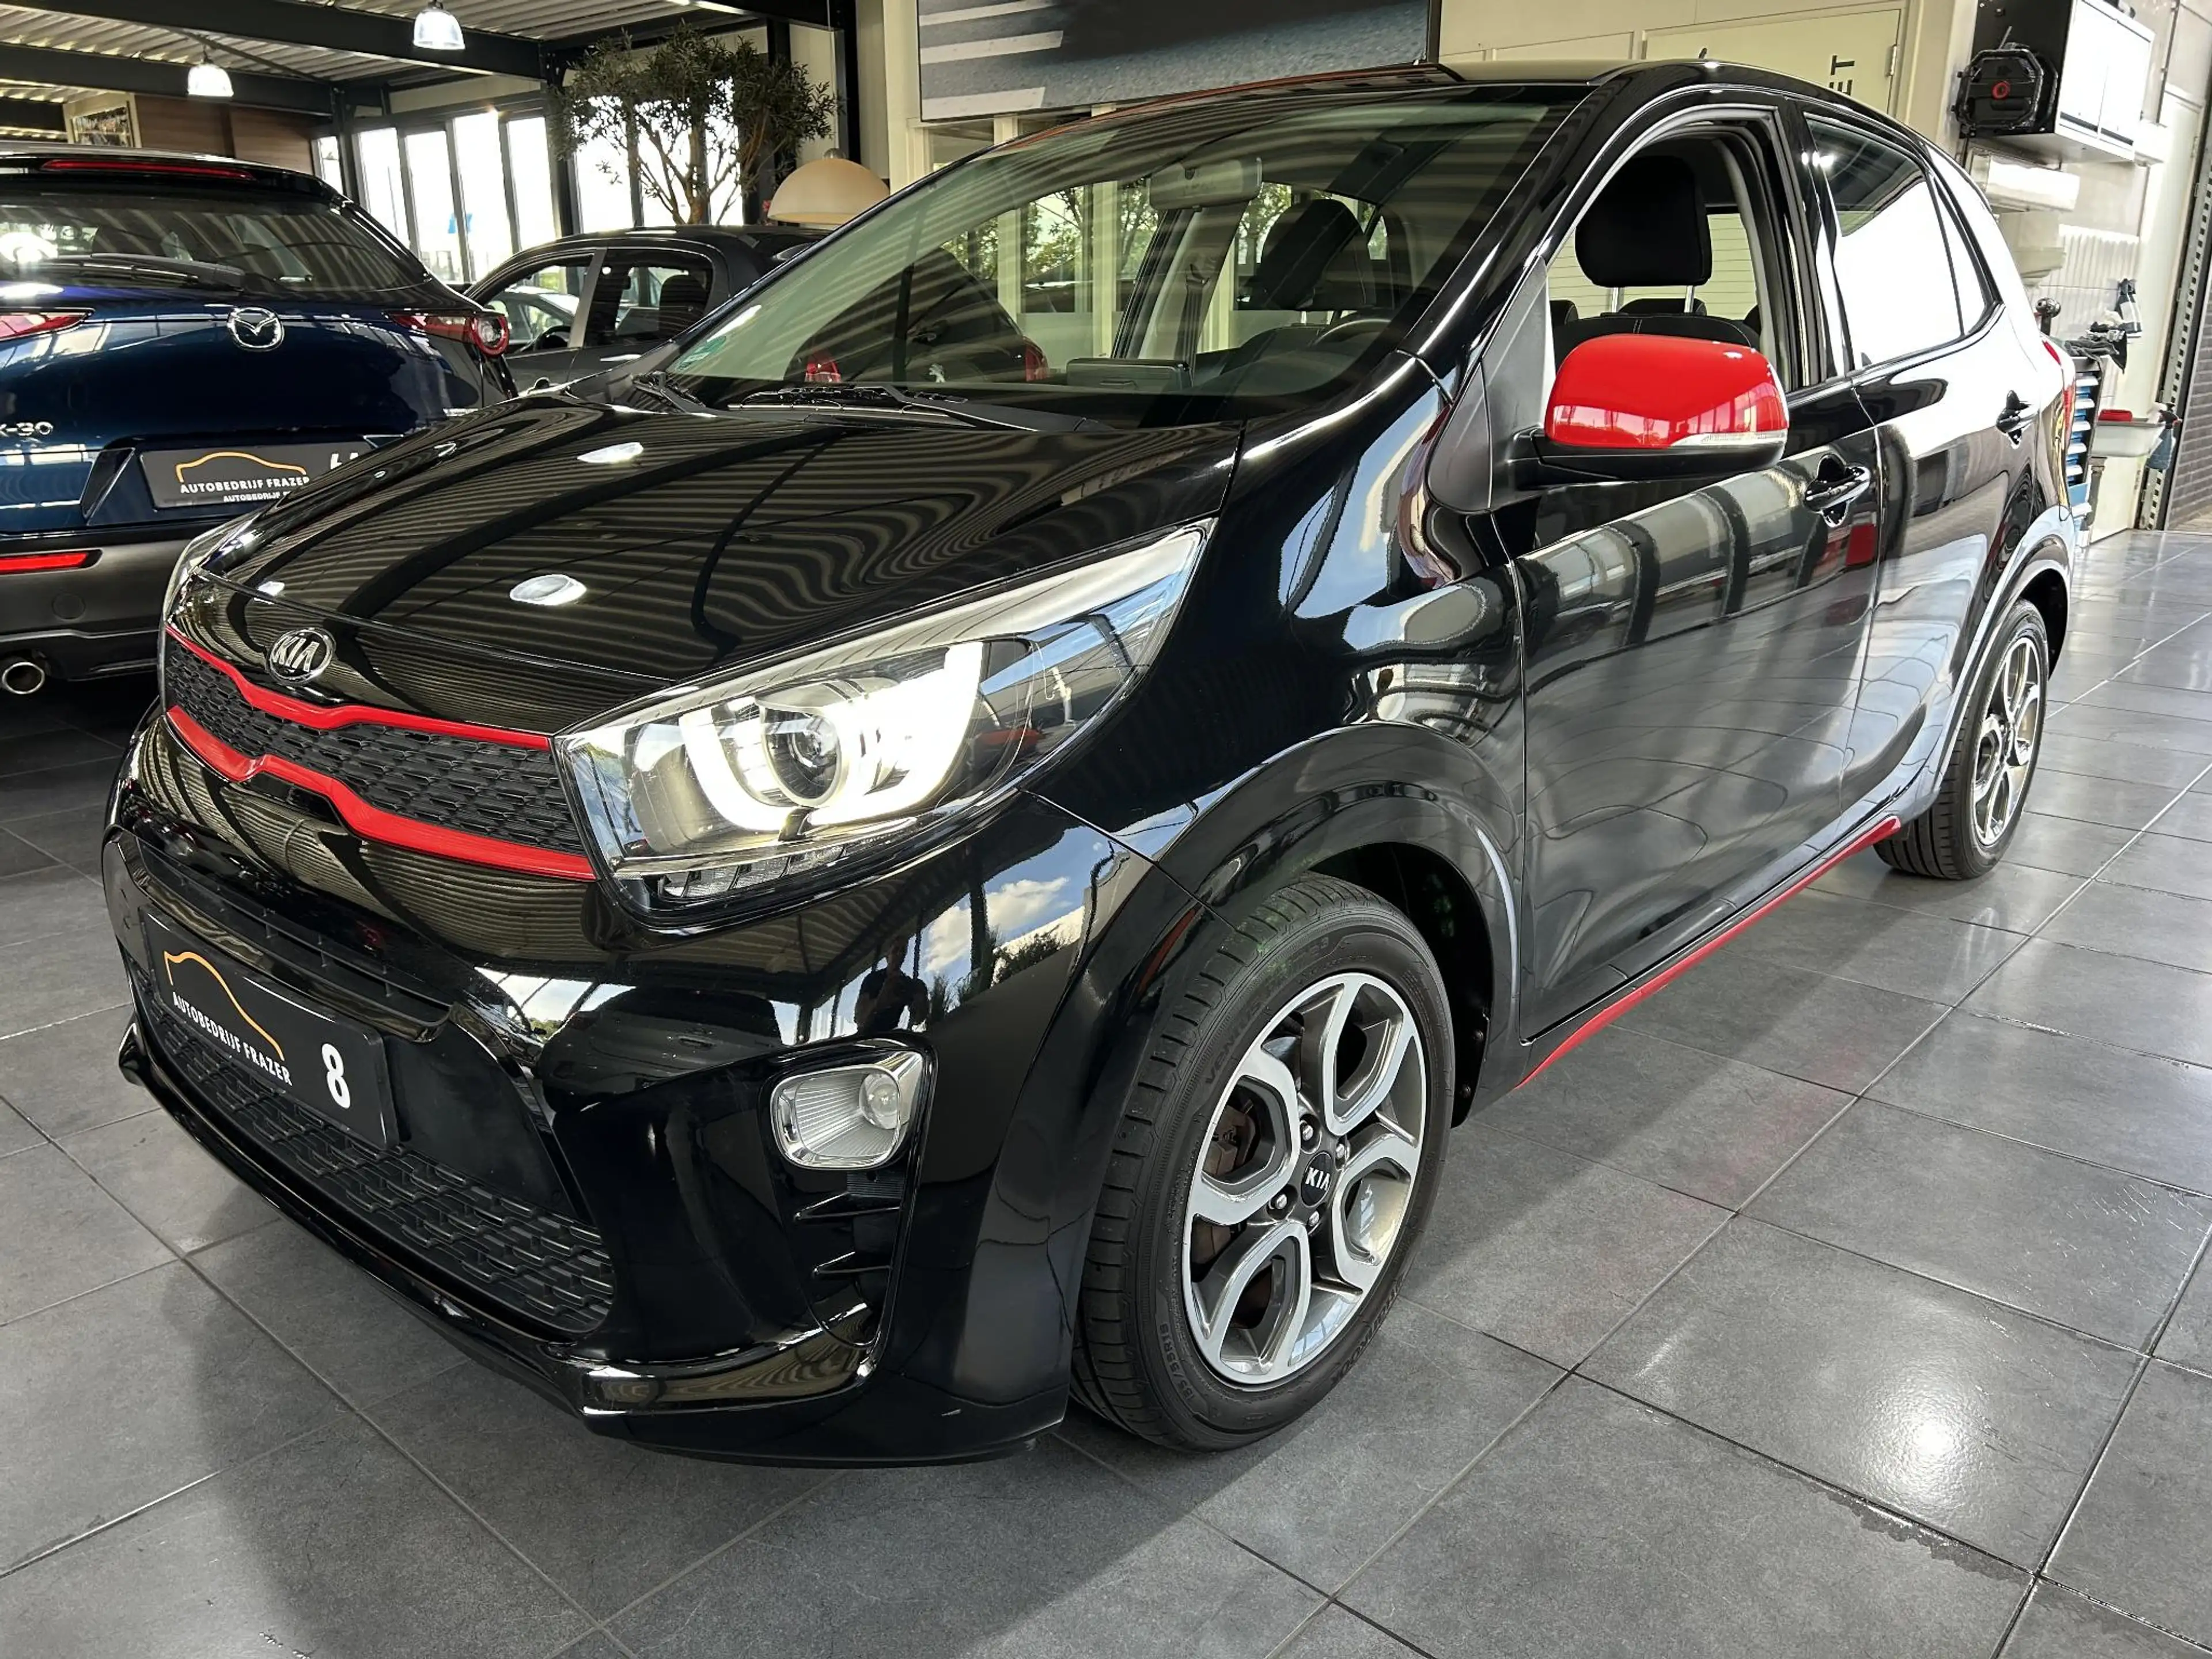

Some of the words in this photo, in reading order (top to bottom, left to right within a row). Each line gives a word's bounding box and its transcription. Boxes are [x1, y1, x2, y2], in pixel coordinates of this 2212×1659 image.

[180, 479, 263, 494] AUTOBEDRIJF
[223, 491, 281, 503] AUTOBEDRIJF
[272, 635, 320, 673] KIA
[173, 991, 241, 1053] AUTOBEDRIJF
[243, 1041, 293, 1086] FRAZER
[321, 1043, 351, 1109] 8
[1305, 1166, 1330, 1191] KIA
